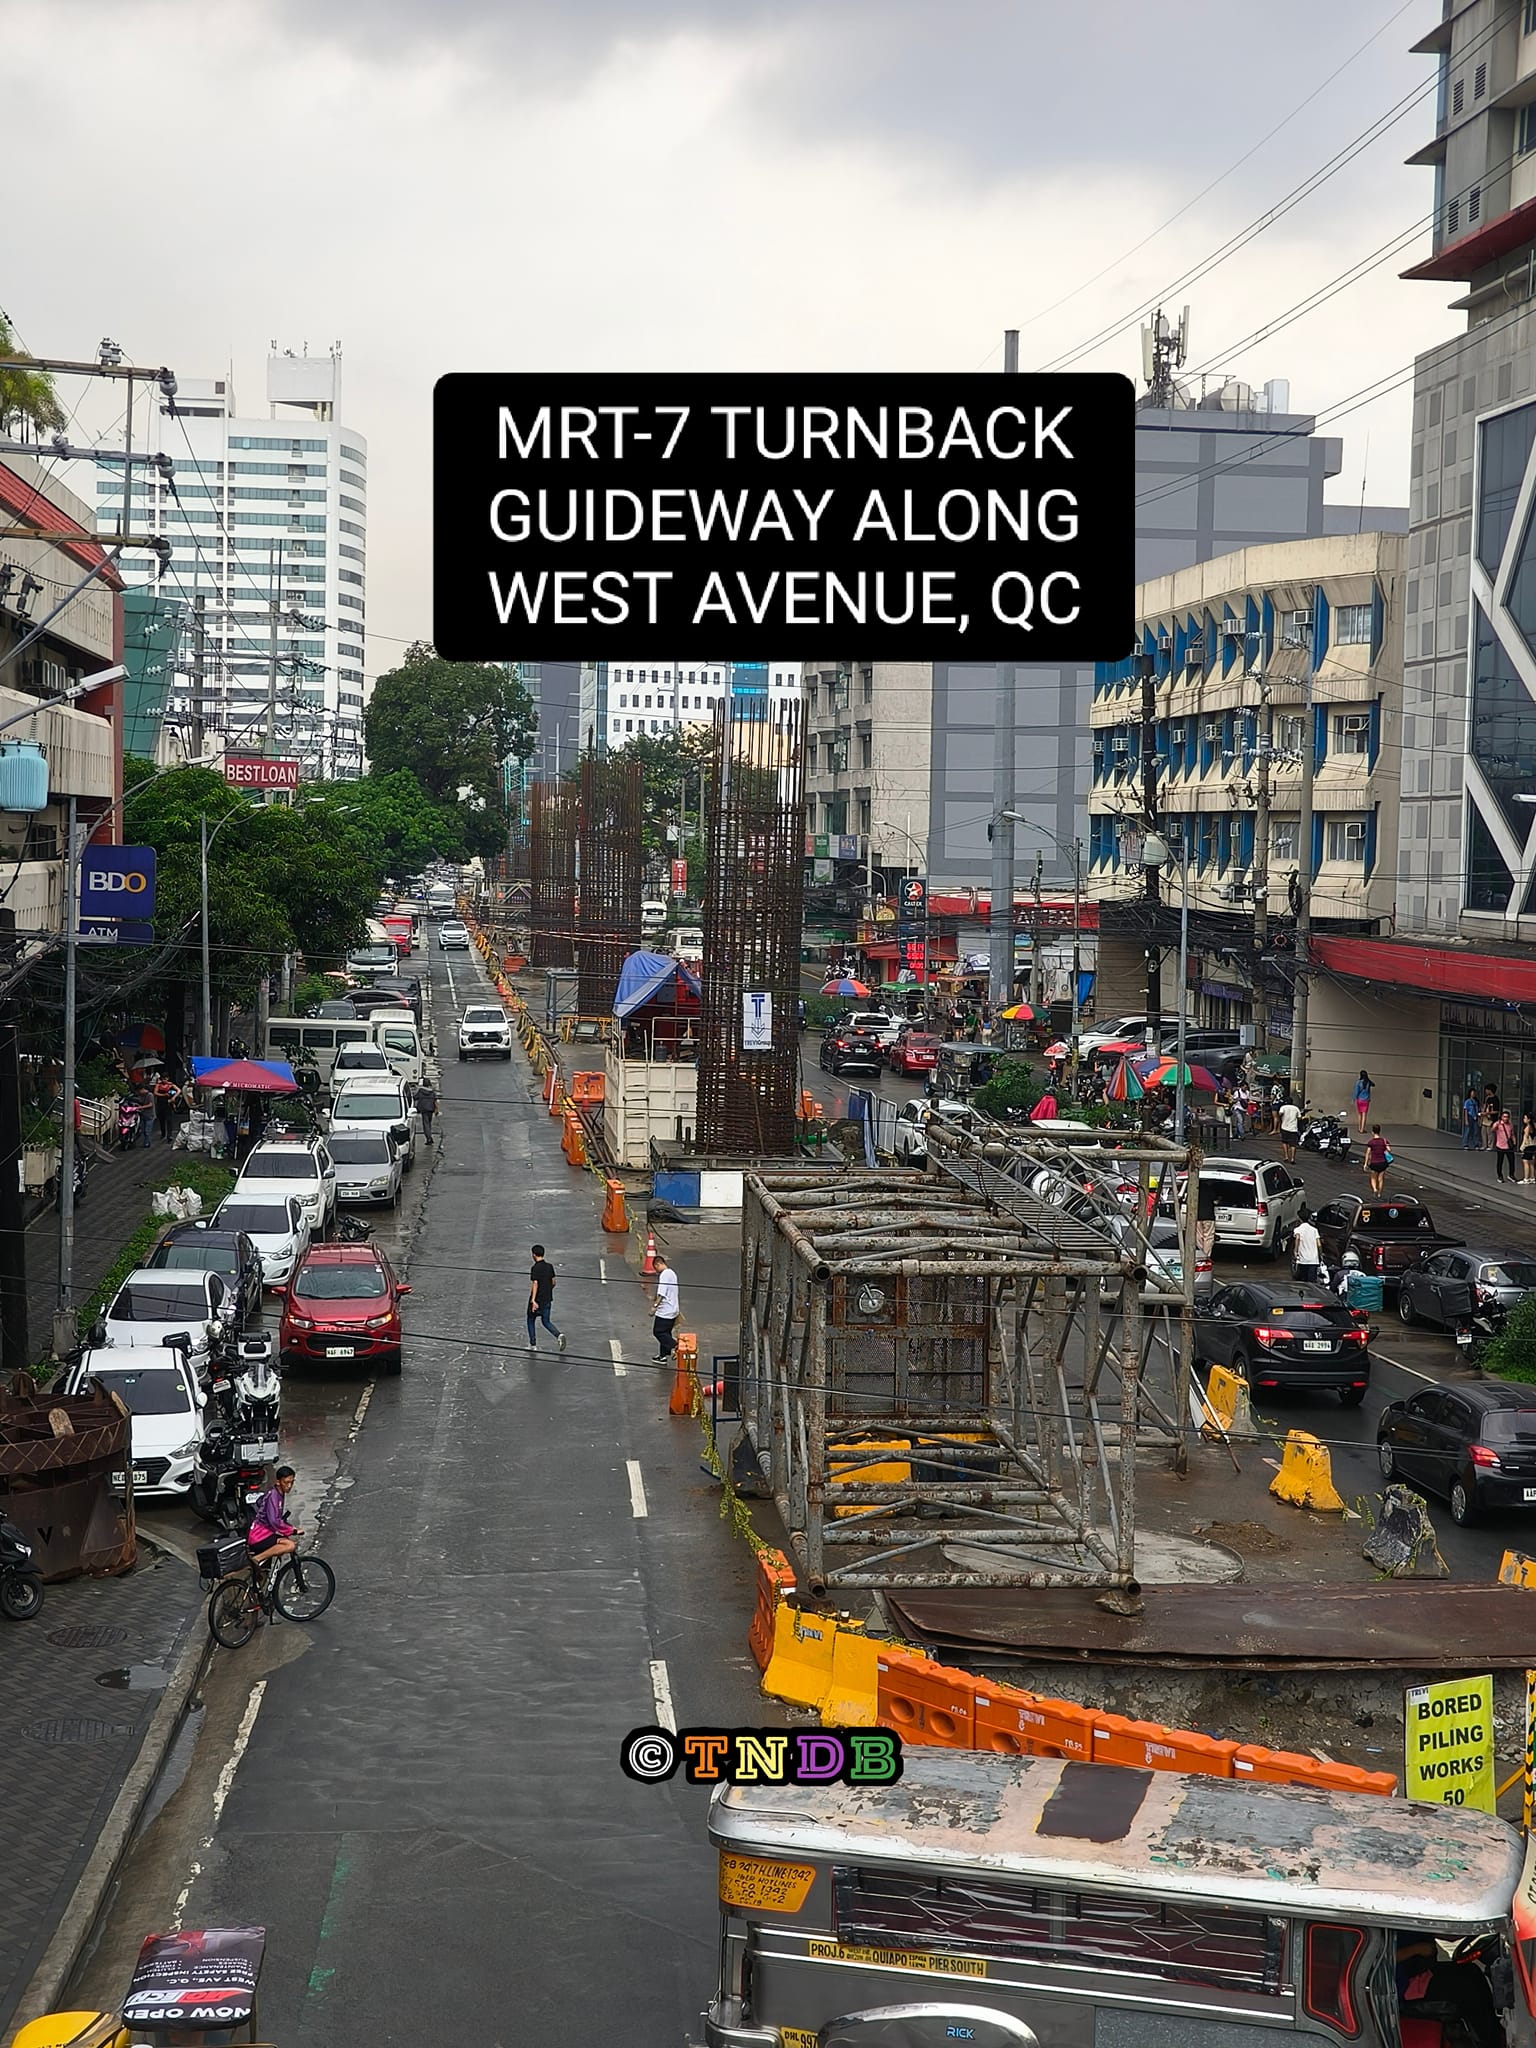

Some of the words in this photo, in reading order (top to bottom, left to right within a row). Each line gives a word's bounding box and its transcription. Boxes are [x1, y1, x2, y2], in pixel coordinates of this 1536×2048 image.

[89, 871, 147, 893] BDO
[88, 926, 119, 938] ATM
[232, 1081, 272, 1090] MICROMATIC
[1418, 1693, 1483, 1720] BORED
[1418, 1724, 1484, 1752] PILING
[1419, 1755, 1484, 1781] WORKS
[1443, 1788, 1465, 1806] 50
[811, 1943, 845, 1959] PROJ.6
[872, 1950, 907, 1966] QUIAPO
[227, 1969, 254, 1977] FREE
[929, 1956, 950, 1972] PIER
[950, 1959, 984, 1976] SOUTH
[133, 1970, 190, 1983] INSPECTION
[223, 1977, 257, 1987] WEST
[189, 2007, 252, 2018] NOW
[784, 2030, 799, 2042] DHL
[946, 2026, 975, 2040] RICK
